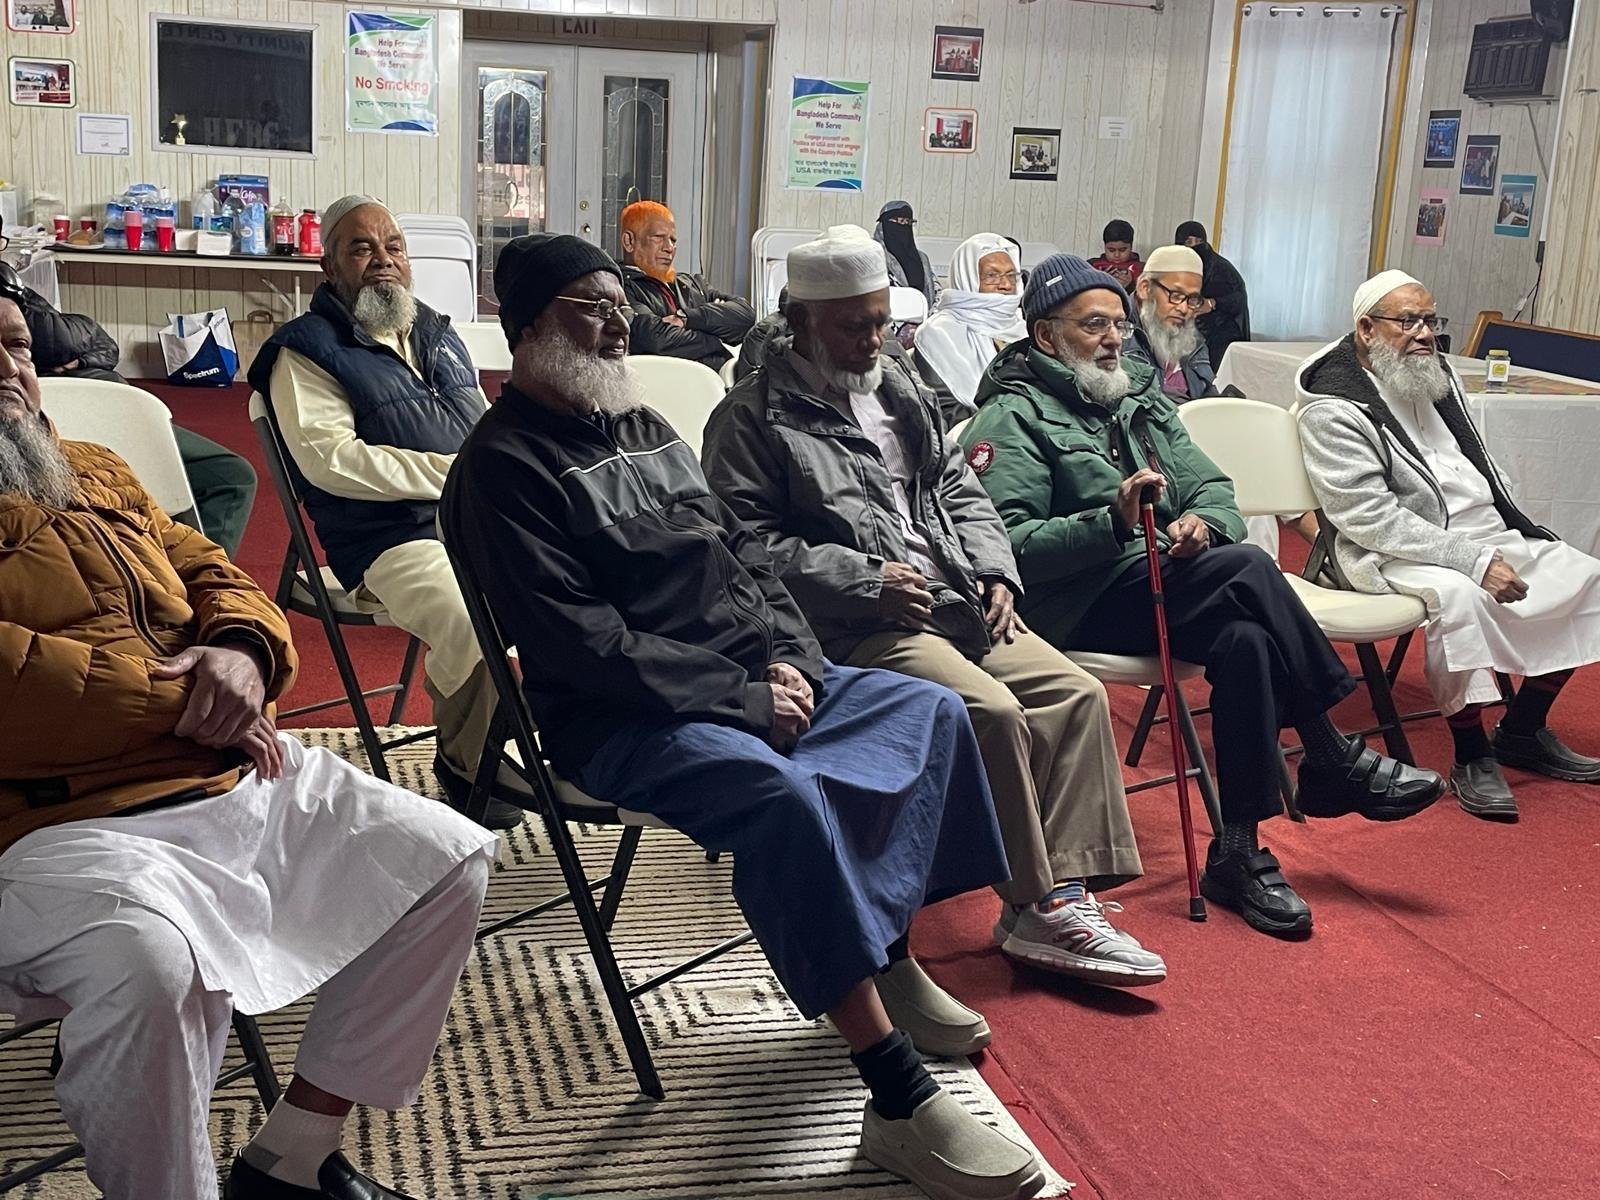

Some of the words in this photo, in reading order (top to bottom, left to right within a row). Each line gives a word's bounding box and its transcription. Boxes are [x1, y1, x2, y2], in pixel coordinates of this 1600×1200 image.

[355, 76, 372, 89] No
[376, 77, 429, 96] Smoking
[818, 101, 831, 109] Help
[797, 110, 829, 118] Bangladesh
[831, 113, 861, 121] Community
[825, 122, 842, 130] Serve
[183, 367, 220, 380] Spectrum
